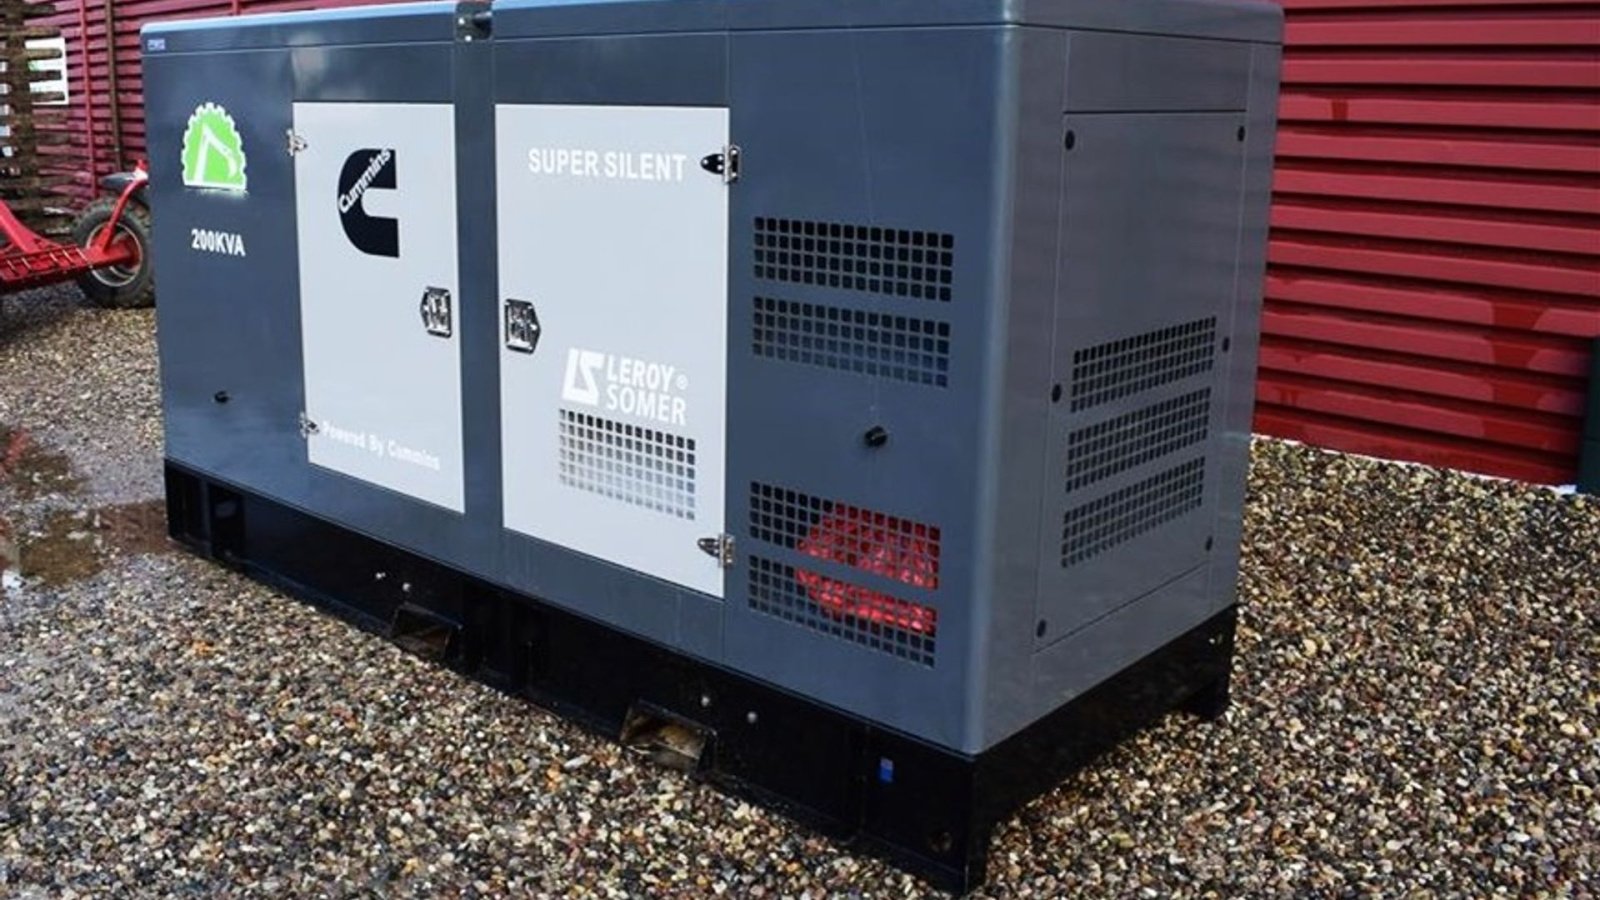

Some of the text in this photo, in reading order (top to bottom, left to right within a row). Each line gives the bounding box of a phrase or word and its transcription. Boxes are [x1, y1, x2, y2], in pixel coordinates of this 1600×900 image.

[339, 147, 391, 213] Cummins
[528, 147, 687, 182] SUPER SILENT
[191, 228, 246, 257] 200KVA
[607, 354, 675, 393] LEROY
[605, 383, 687, 426] SOMER
[322, 420, 365, 449] Powered
[369, 434, 383, 458] By
